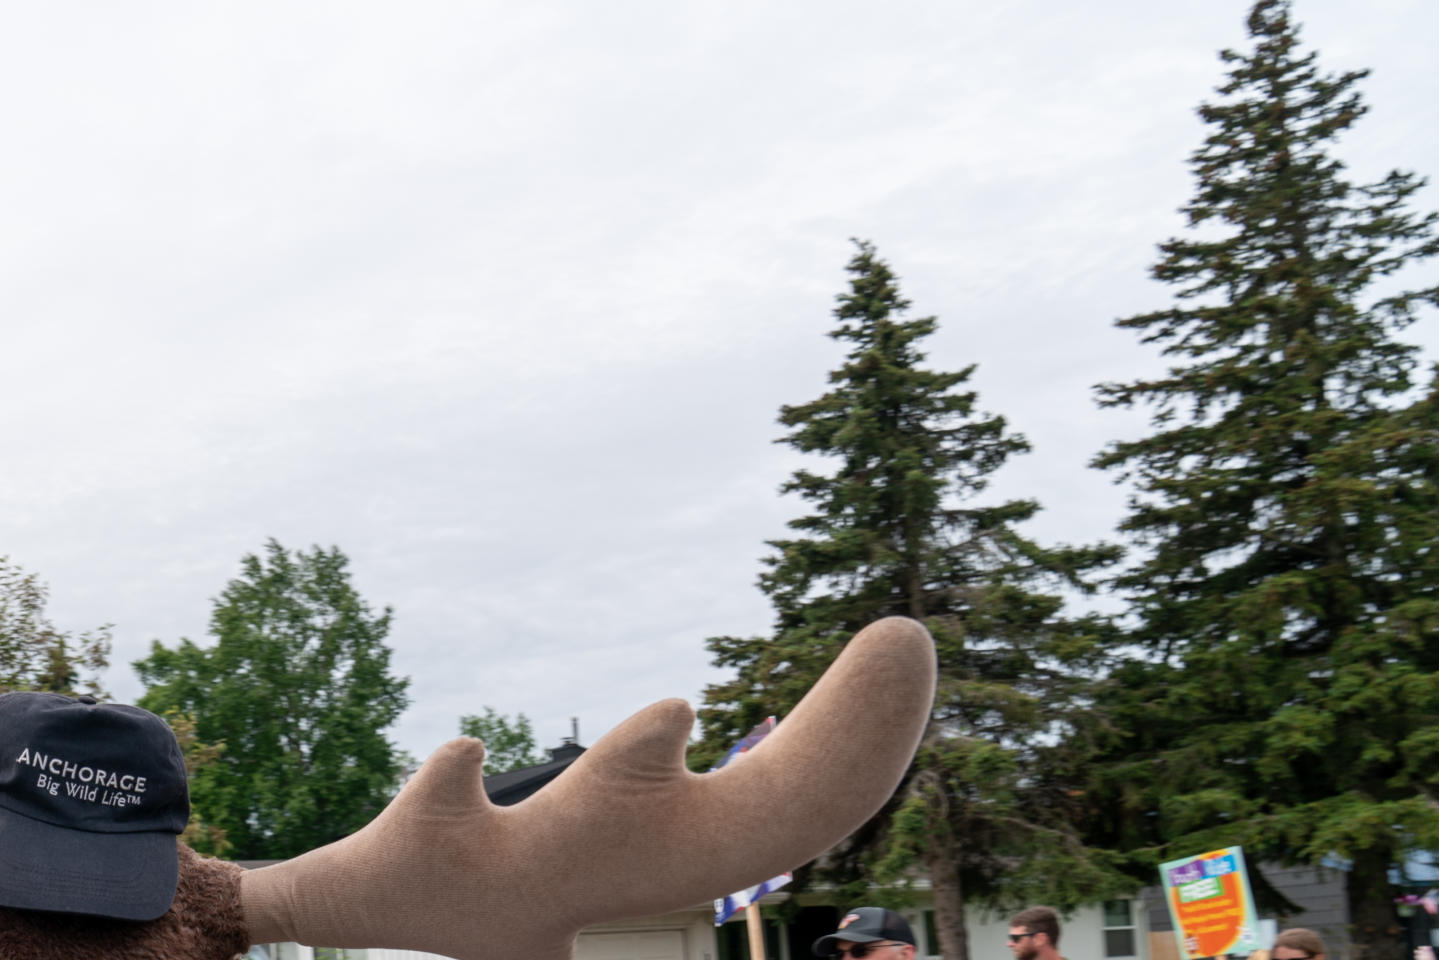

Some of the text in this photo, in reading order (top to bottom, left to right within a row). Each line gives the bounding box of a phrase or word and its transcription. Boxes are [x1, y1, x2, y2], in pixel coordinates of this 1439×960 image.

[16, 748, 147, 792] ANCHORAGE
[37, 774, 60, 796] Big
[66, 782, 98, 802] Wild
